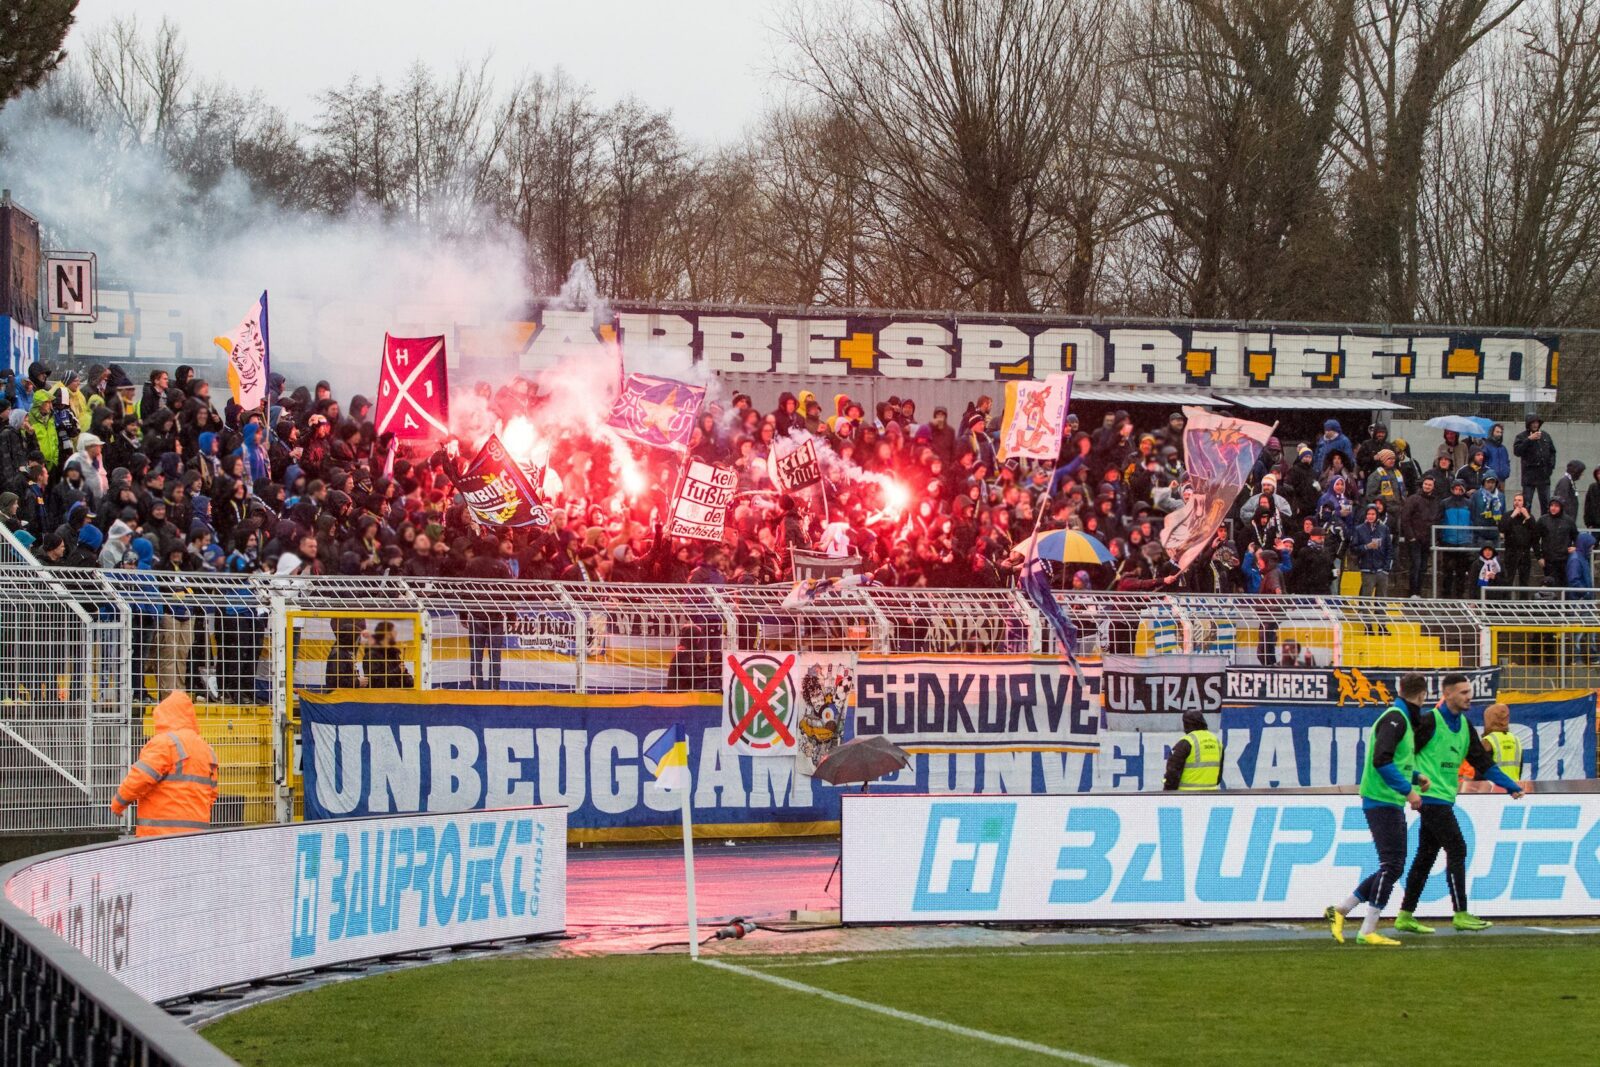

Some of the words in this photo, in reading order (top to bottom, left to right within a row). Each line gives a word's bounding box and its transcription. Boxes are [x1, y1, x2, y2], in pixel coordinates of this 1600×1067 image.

[57, 264, 84, 309] N
[395, 348, 409, 366] H
[878, 321, 1548, 394] SPORTFELD
[404, 412, 420, 429] A
[857, 673, 1099, 735] SÜDKURVE
[1108, 675, 1222, 711] ULTRAS
[1226, 672, 1328, 699] REFUGEES
[328, 819, 533, 941] BAUPROJEKT
